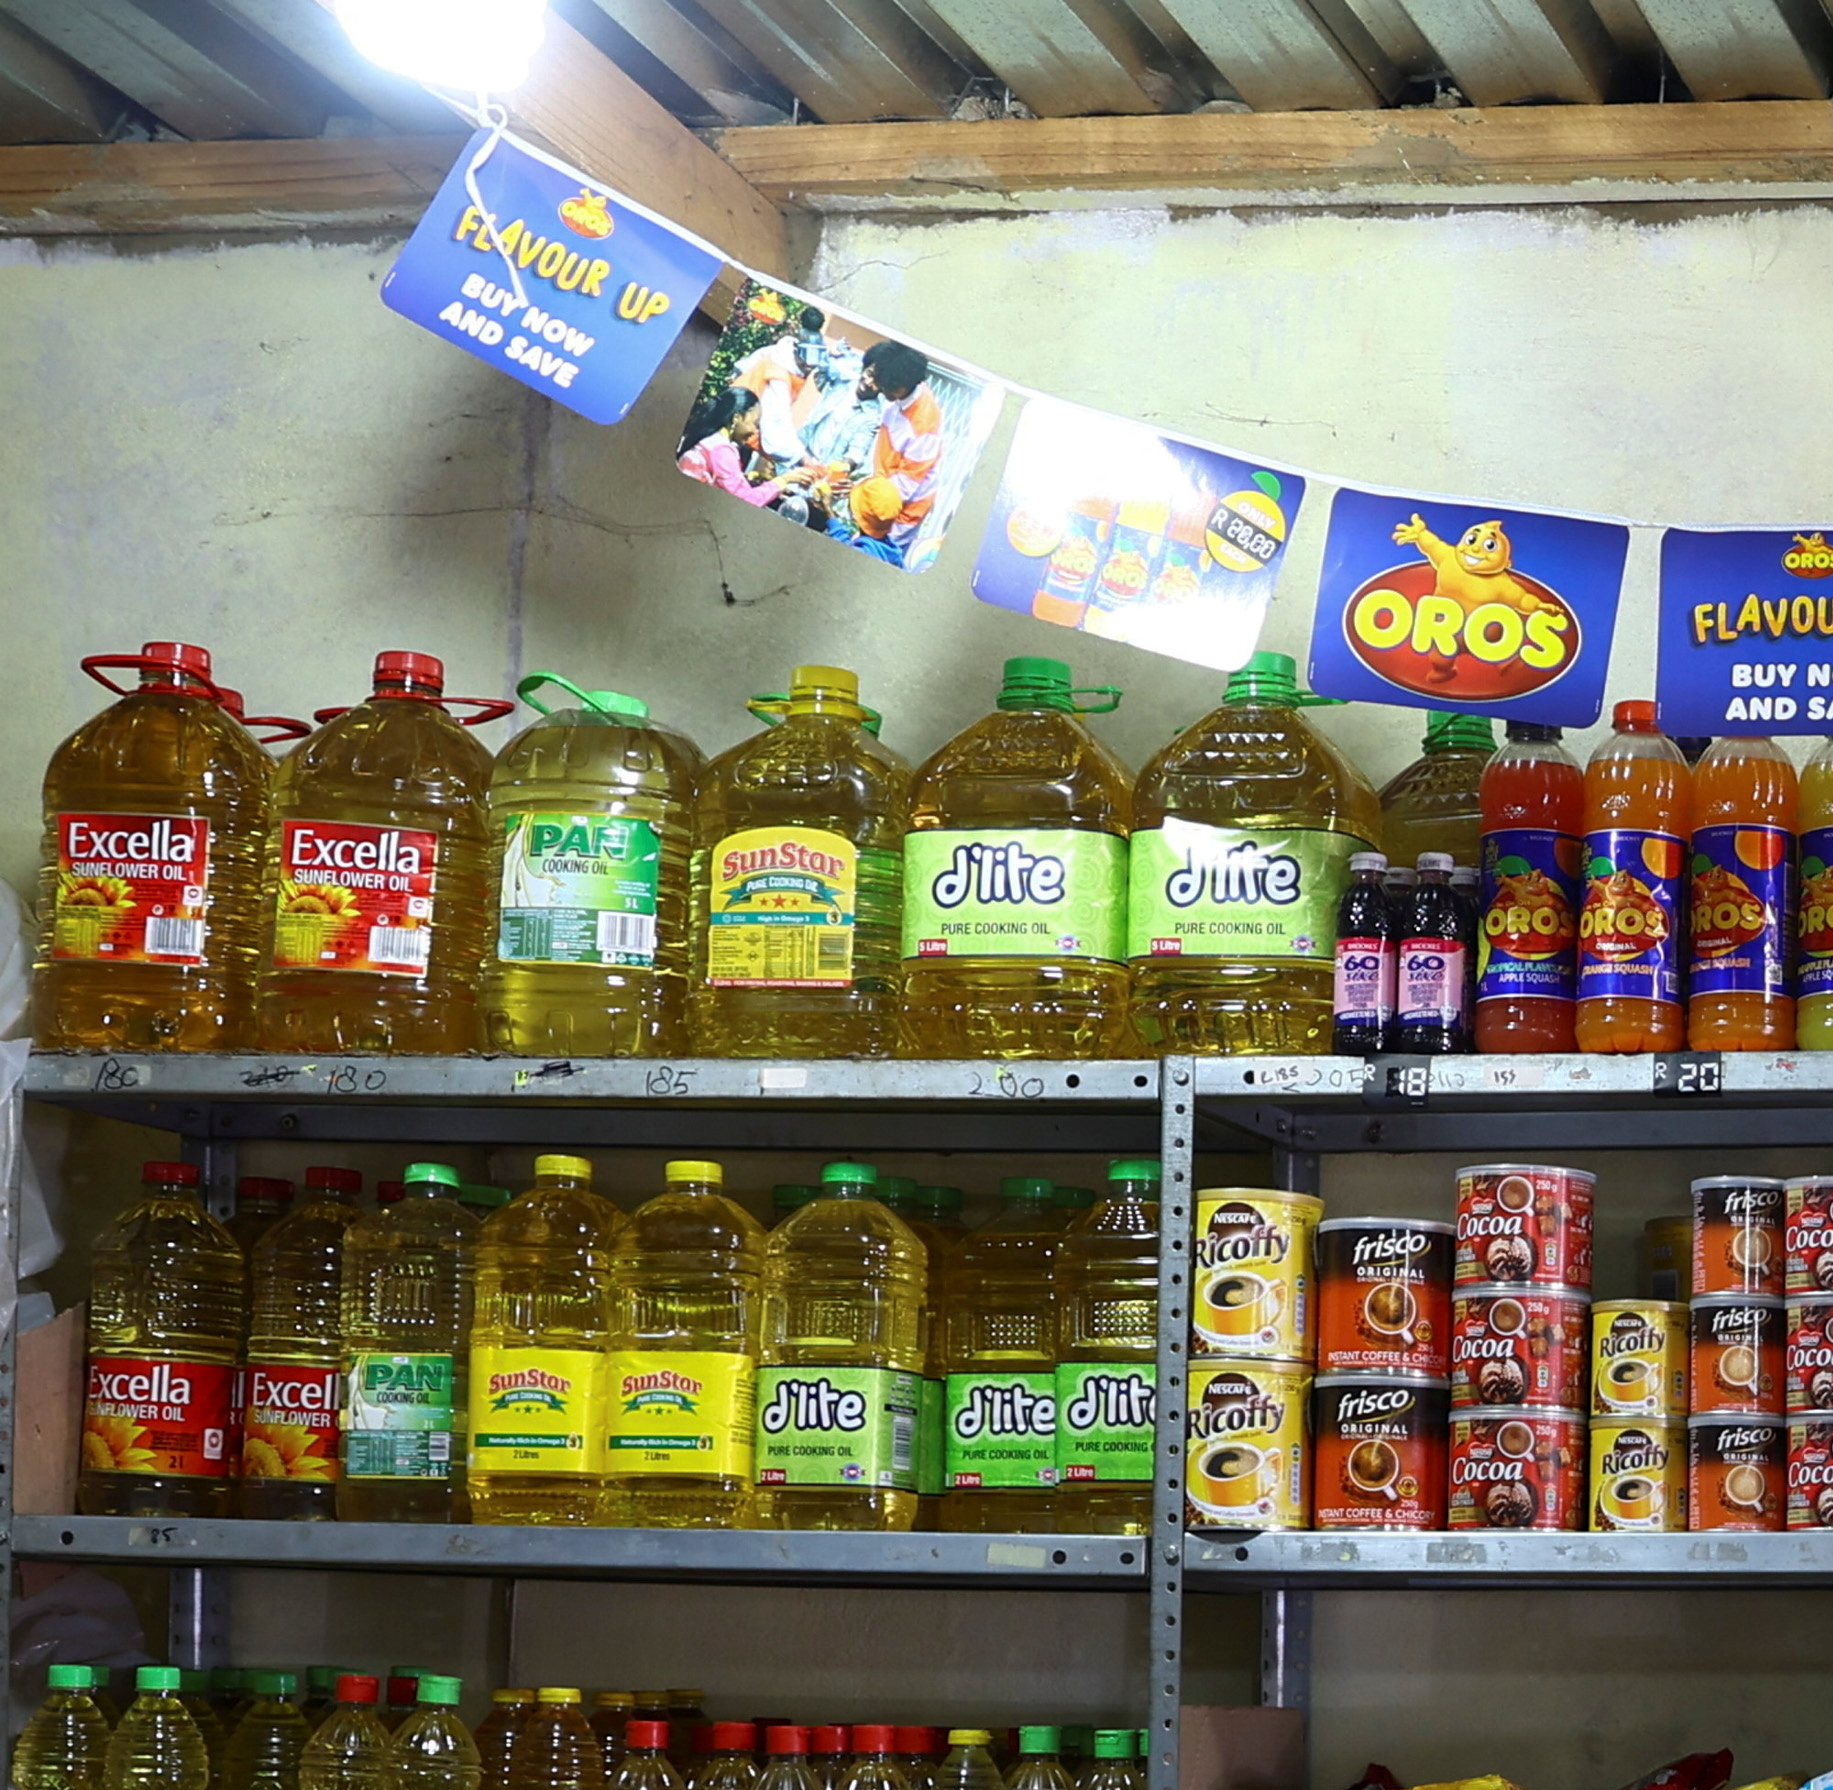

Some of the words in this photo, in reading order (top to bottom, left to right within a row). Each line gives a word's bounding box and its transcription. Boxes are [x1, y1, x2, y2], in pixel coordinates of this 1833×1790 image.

[1354, 589, 1568, 670] OROS
[1731, 663, 1798, 689] BUY
[1725, 696, 1797, 721] AND
[68, 821, 195, 863] Excella
[290, 831, 421, 874] Excella
[530, 821, 627, 860] PAN
[72, 860, 160, 882] SUNFLOWER
[163, 864, 187, 882] OIL
[542, 859, 589, 875] COOKING
[592, 860, 609, 876] OIL
[722, 842, 845, 881] SunStar
[932, 841, 1067, 909] d'lite
[941, 923, 970, 937] PURE
[974, 921, 1030, 936] COOKING
[1033, 920, 1051, 935] OIL
[1678, 1062, 1719, 1091] 20
[1455, 1215, 1523, 1241] Cocoa
[1195, 1225, 1290, 1268] Ricoffy
[1352, 1232, 1428, 1267] frisco
[1356, 1266, 1425, 1279] ORIGINAL
[1318, 1508, 1358, 1520] INSTANT
[1360, 1508, 1394, 1521] COFFEE
[1403, 1510, 1436, 1523] CHICORY
